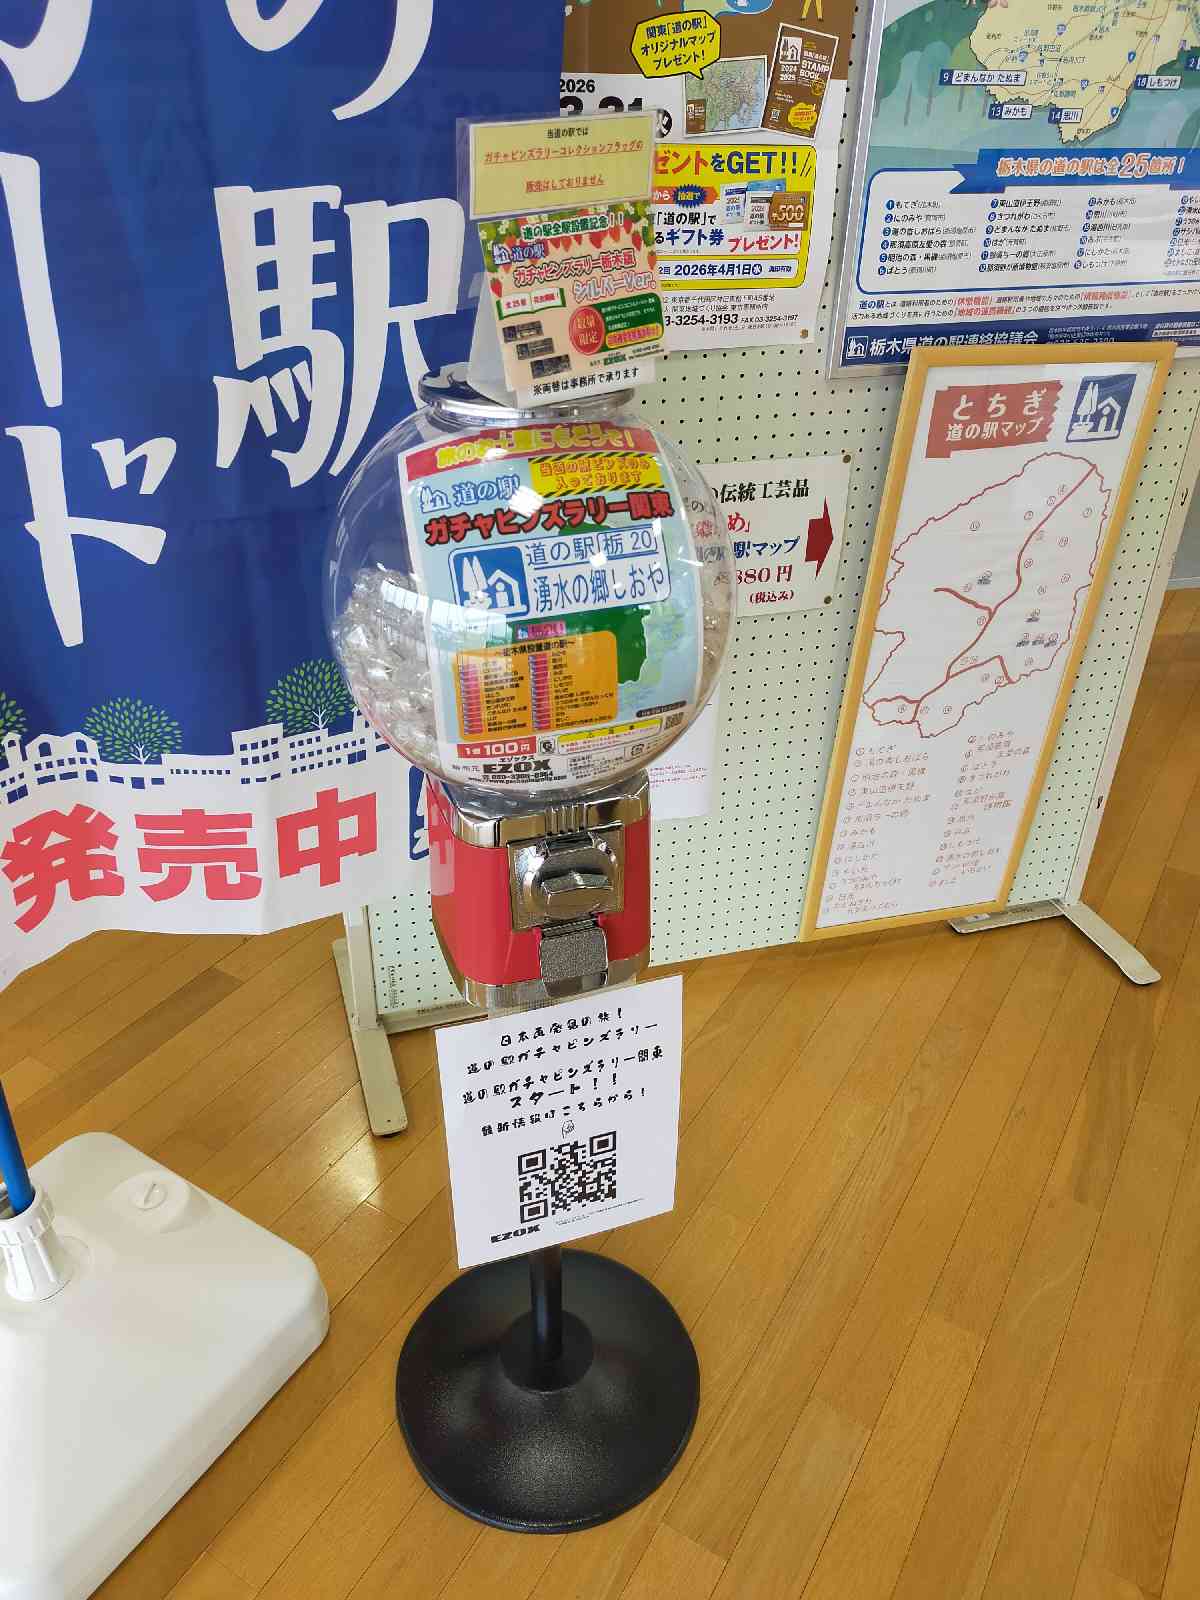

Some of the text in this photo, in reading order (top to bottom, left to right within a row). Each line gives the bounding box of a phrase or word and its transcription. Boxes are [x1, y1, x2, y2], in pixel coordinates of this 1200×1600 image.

[645, 17, 708, 39] 関東「道の駅」
[640, 31, 716, 56] オリジナルマップ
[652, 49, 706, 71] プレゼント!
[560, 79, 595, 93] 2026
[955, 72, 995, 82] どまんなか
[1149, 77, 1177, 87] しもつけ
[1004, 106, 1029, 117] みかも
[650, 210, 717, 227] 「道の駅」で
[728, 233, 799, 253] プレゼント!
[951, 388, 1048, 421] とちぎ
[944, 416, 1044, 443] 道の駅マップ
[454, 474, 521, 505] 道の駅
[533, 561, 666, 613] 湧水の郷しおや
[482, 758, 552, 775] EZOX
[0, 786, 378, 934] 発売中
[489, 1222, 542, 1244] EZOX
